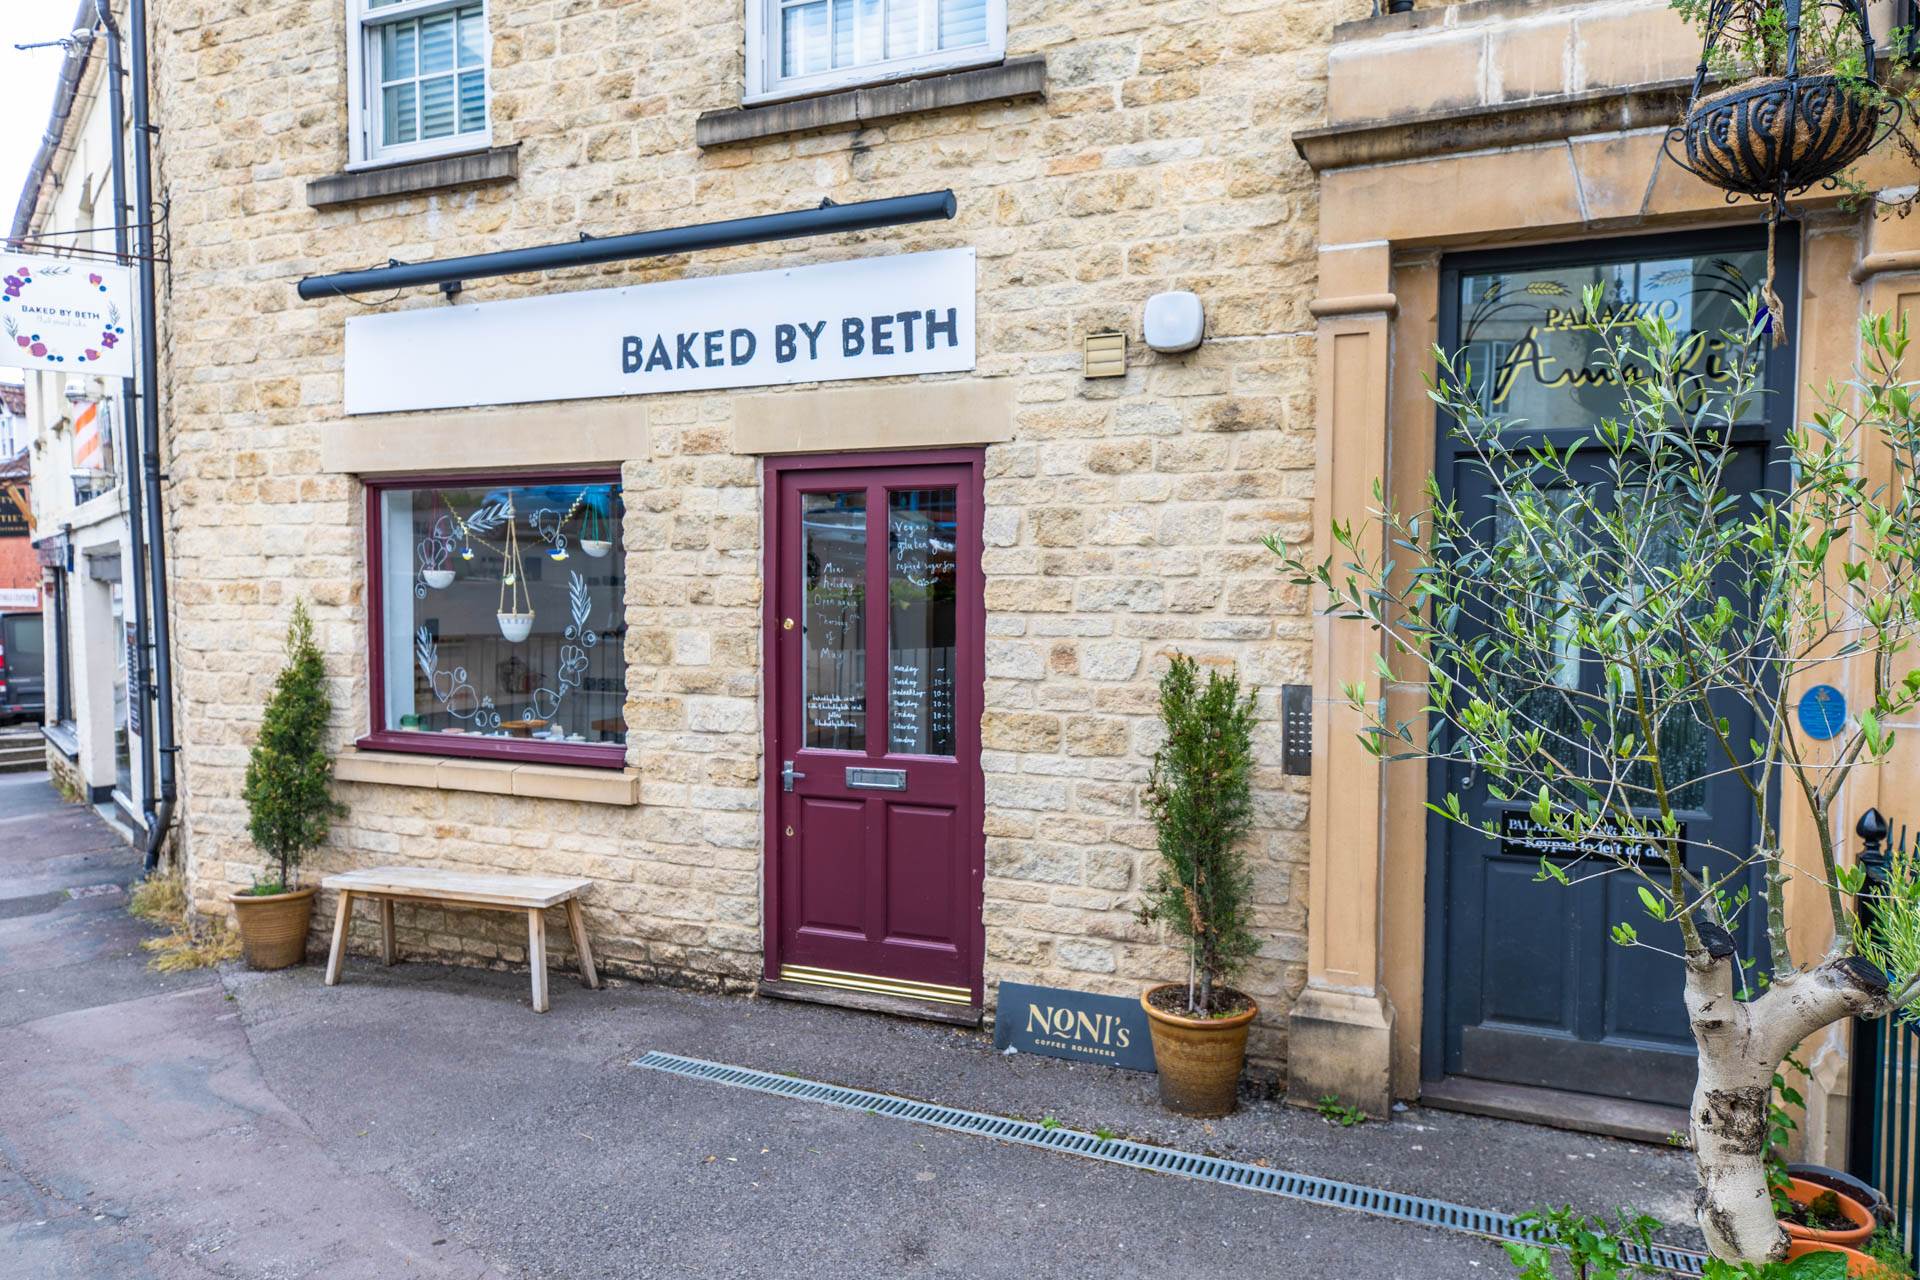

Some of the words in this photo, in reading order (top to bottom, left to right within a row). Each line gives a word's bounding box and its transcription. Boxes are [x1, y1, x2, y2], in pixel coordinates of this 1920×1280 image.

[21, 305, 56, 315] BAKED
[60, 309, 72, 317] BY
[75, 311, 100, 320] BETH
[622, 328, 757, 374] BAKED
[775, 320, 827, 364] BY
[842, 308, 958, 358] BETH
[894, 521, 928, 538] Vegan
[897, 537, 928, 561] gluten
[1580, 842, 1594, 852] to
[1625, 844, 1642, 856] of
[1035, 1038, 1067, 1050] COFFEE
[1071, 1044, 1116, 1058] ROASTERS
